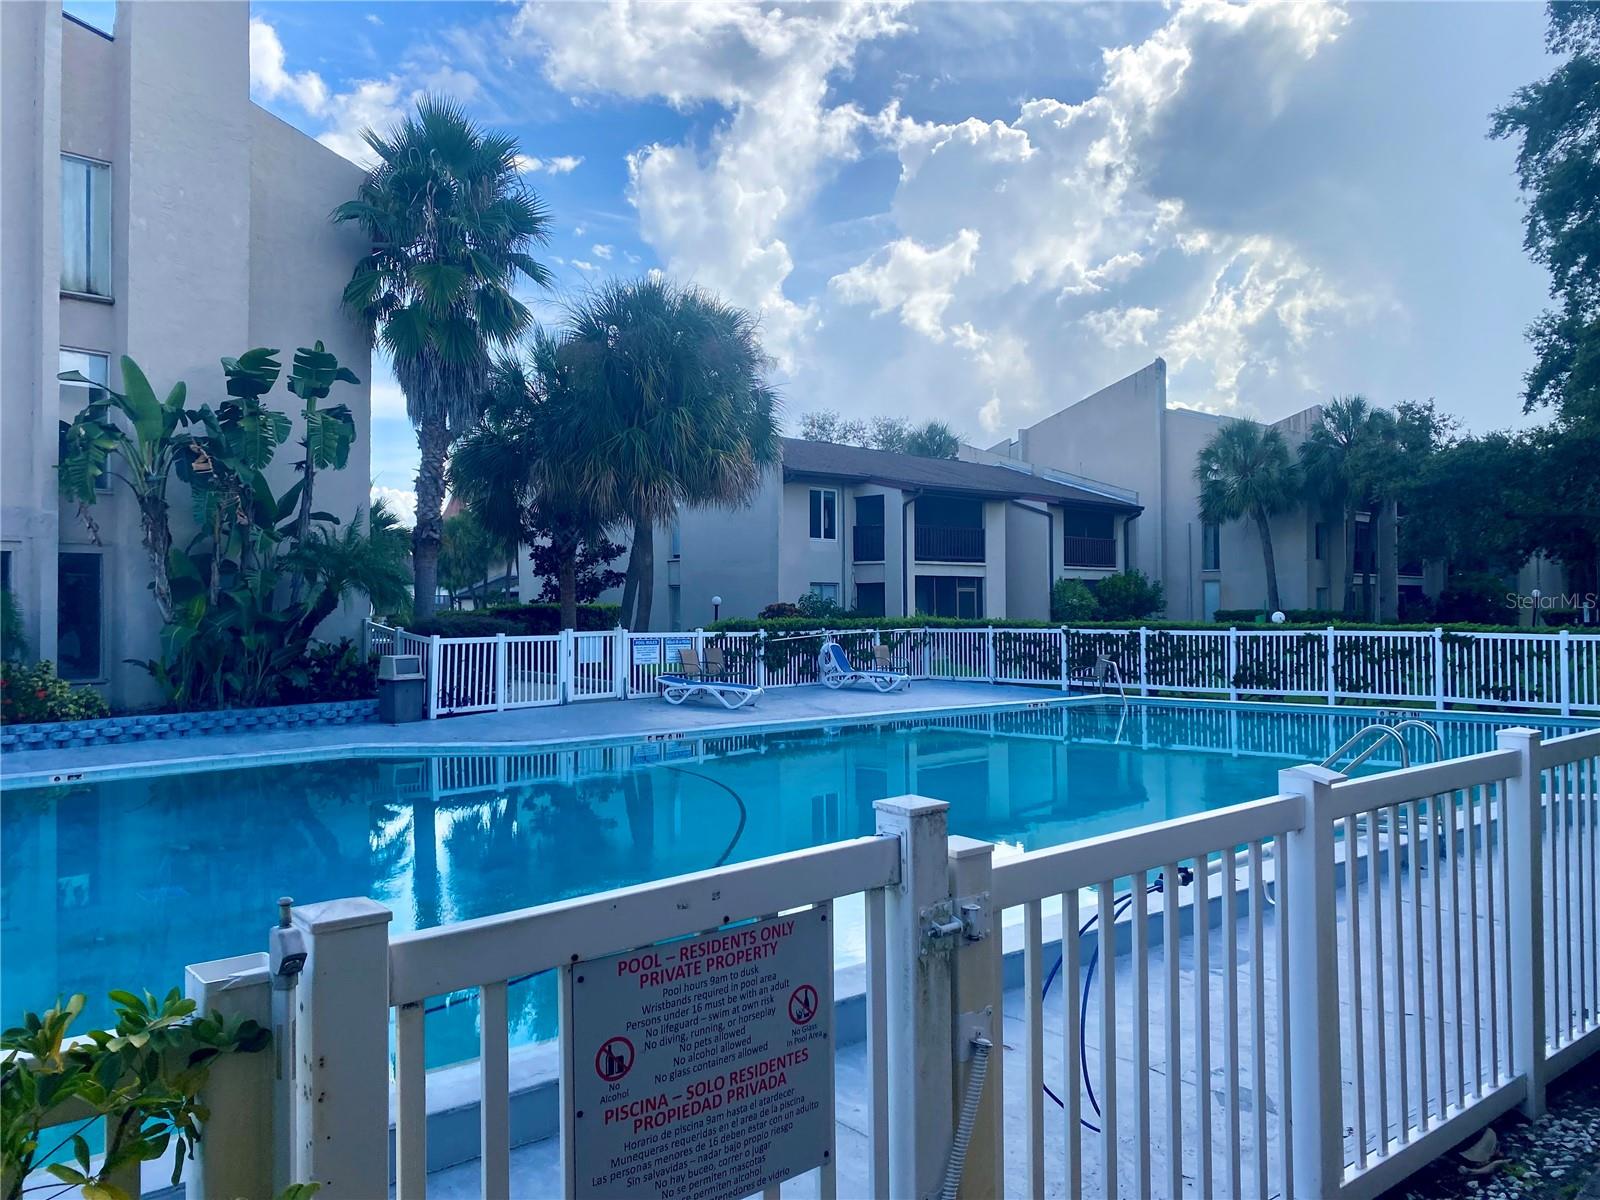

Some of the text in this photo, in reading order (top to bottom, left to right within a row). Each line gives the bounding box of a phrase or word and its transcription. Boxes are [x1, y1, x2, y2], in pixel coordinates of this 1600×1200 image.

[618, 953, 661, 976] POOL
[680, 930, 756, 961] RESIDENTS
[760, 920, 794, 941] ONLY
[639, 940, 777, 988] PRIVATE PROPERTY
[642, 973, 776, 1014] Wristbands required in pool area
[662, 984, 681, 997] Pool
[684, 979, 707, 992] hours
[709, 974, 727, 985] 9am
[740, 965, 758, 977] dusk
[626, 979, 788, 1031] Persons under 16 must be with an adult
[646, 1028, 657, 1038] No
[660, 1015, 698, 1034] lifeguard
[708, 1008, 728, 1020] swim
[732, 1005, 739, 1014] at
[742, 1001, 758, 1011] own
[761, 995, 774, 1005] risk
[644, 1007, 775, 1050] No diving, running, or horseplay
[679, 1025, 745, 1052] No pets allowed
[654, 1040, 767, 1084] No glass containers allowed
[673, 1035, 751, 1066] No alcohol allowed
[600, 1088, 629, 1104] Alcohol
[604, 1093, 668, 1125] PISCINA
[686, 1075, 724, 1099] SOLO
[731, 1047, 808, 1085] RESIDENTES
[608, 1082, 620, 1091] No
[633, 1071, 786, 1134] PROPIEDAD PRIVADA
